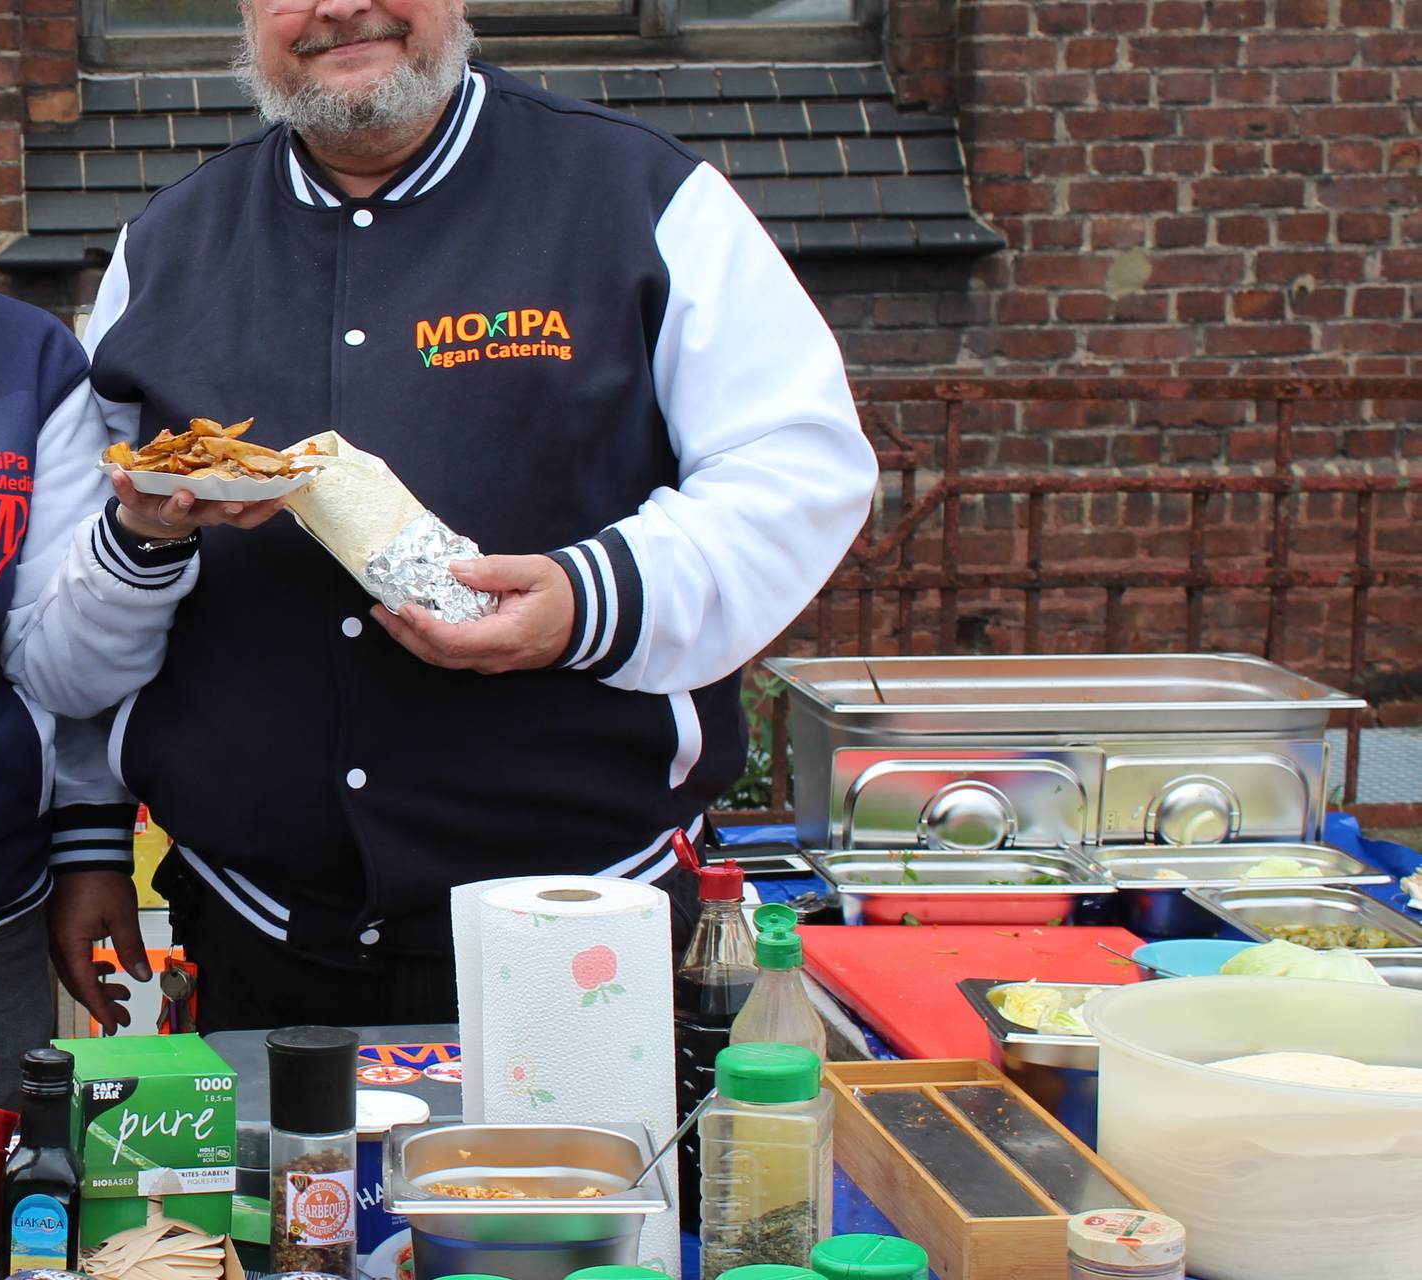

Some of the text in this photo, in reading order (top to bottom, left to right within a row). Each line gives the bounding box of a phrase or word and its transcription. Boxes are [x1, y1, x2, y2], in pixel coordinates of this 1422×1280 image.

[418, 340, 572, 368] Vegan Catering
[194, 1077, 233, 1091] 1000
[92, 1091, 120, 1100] STAR
[112, 1107, 215, 1166] pure
[92, 1178, 134, 1188] BIOBASED
[297, 1199, 347, 1220] BARBEQUE
